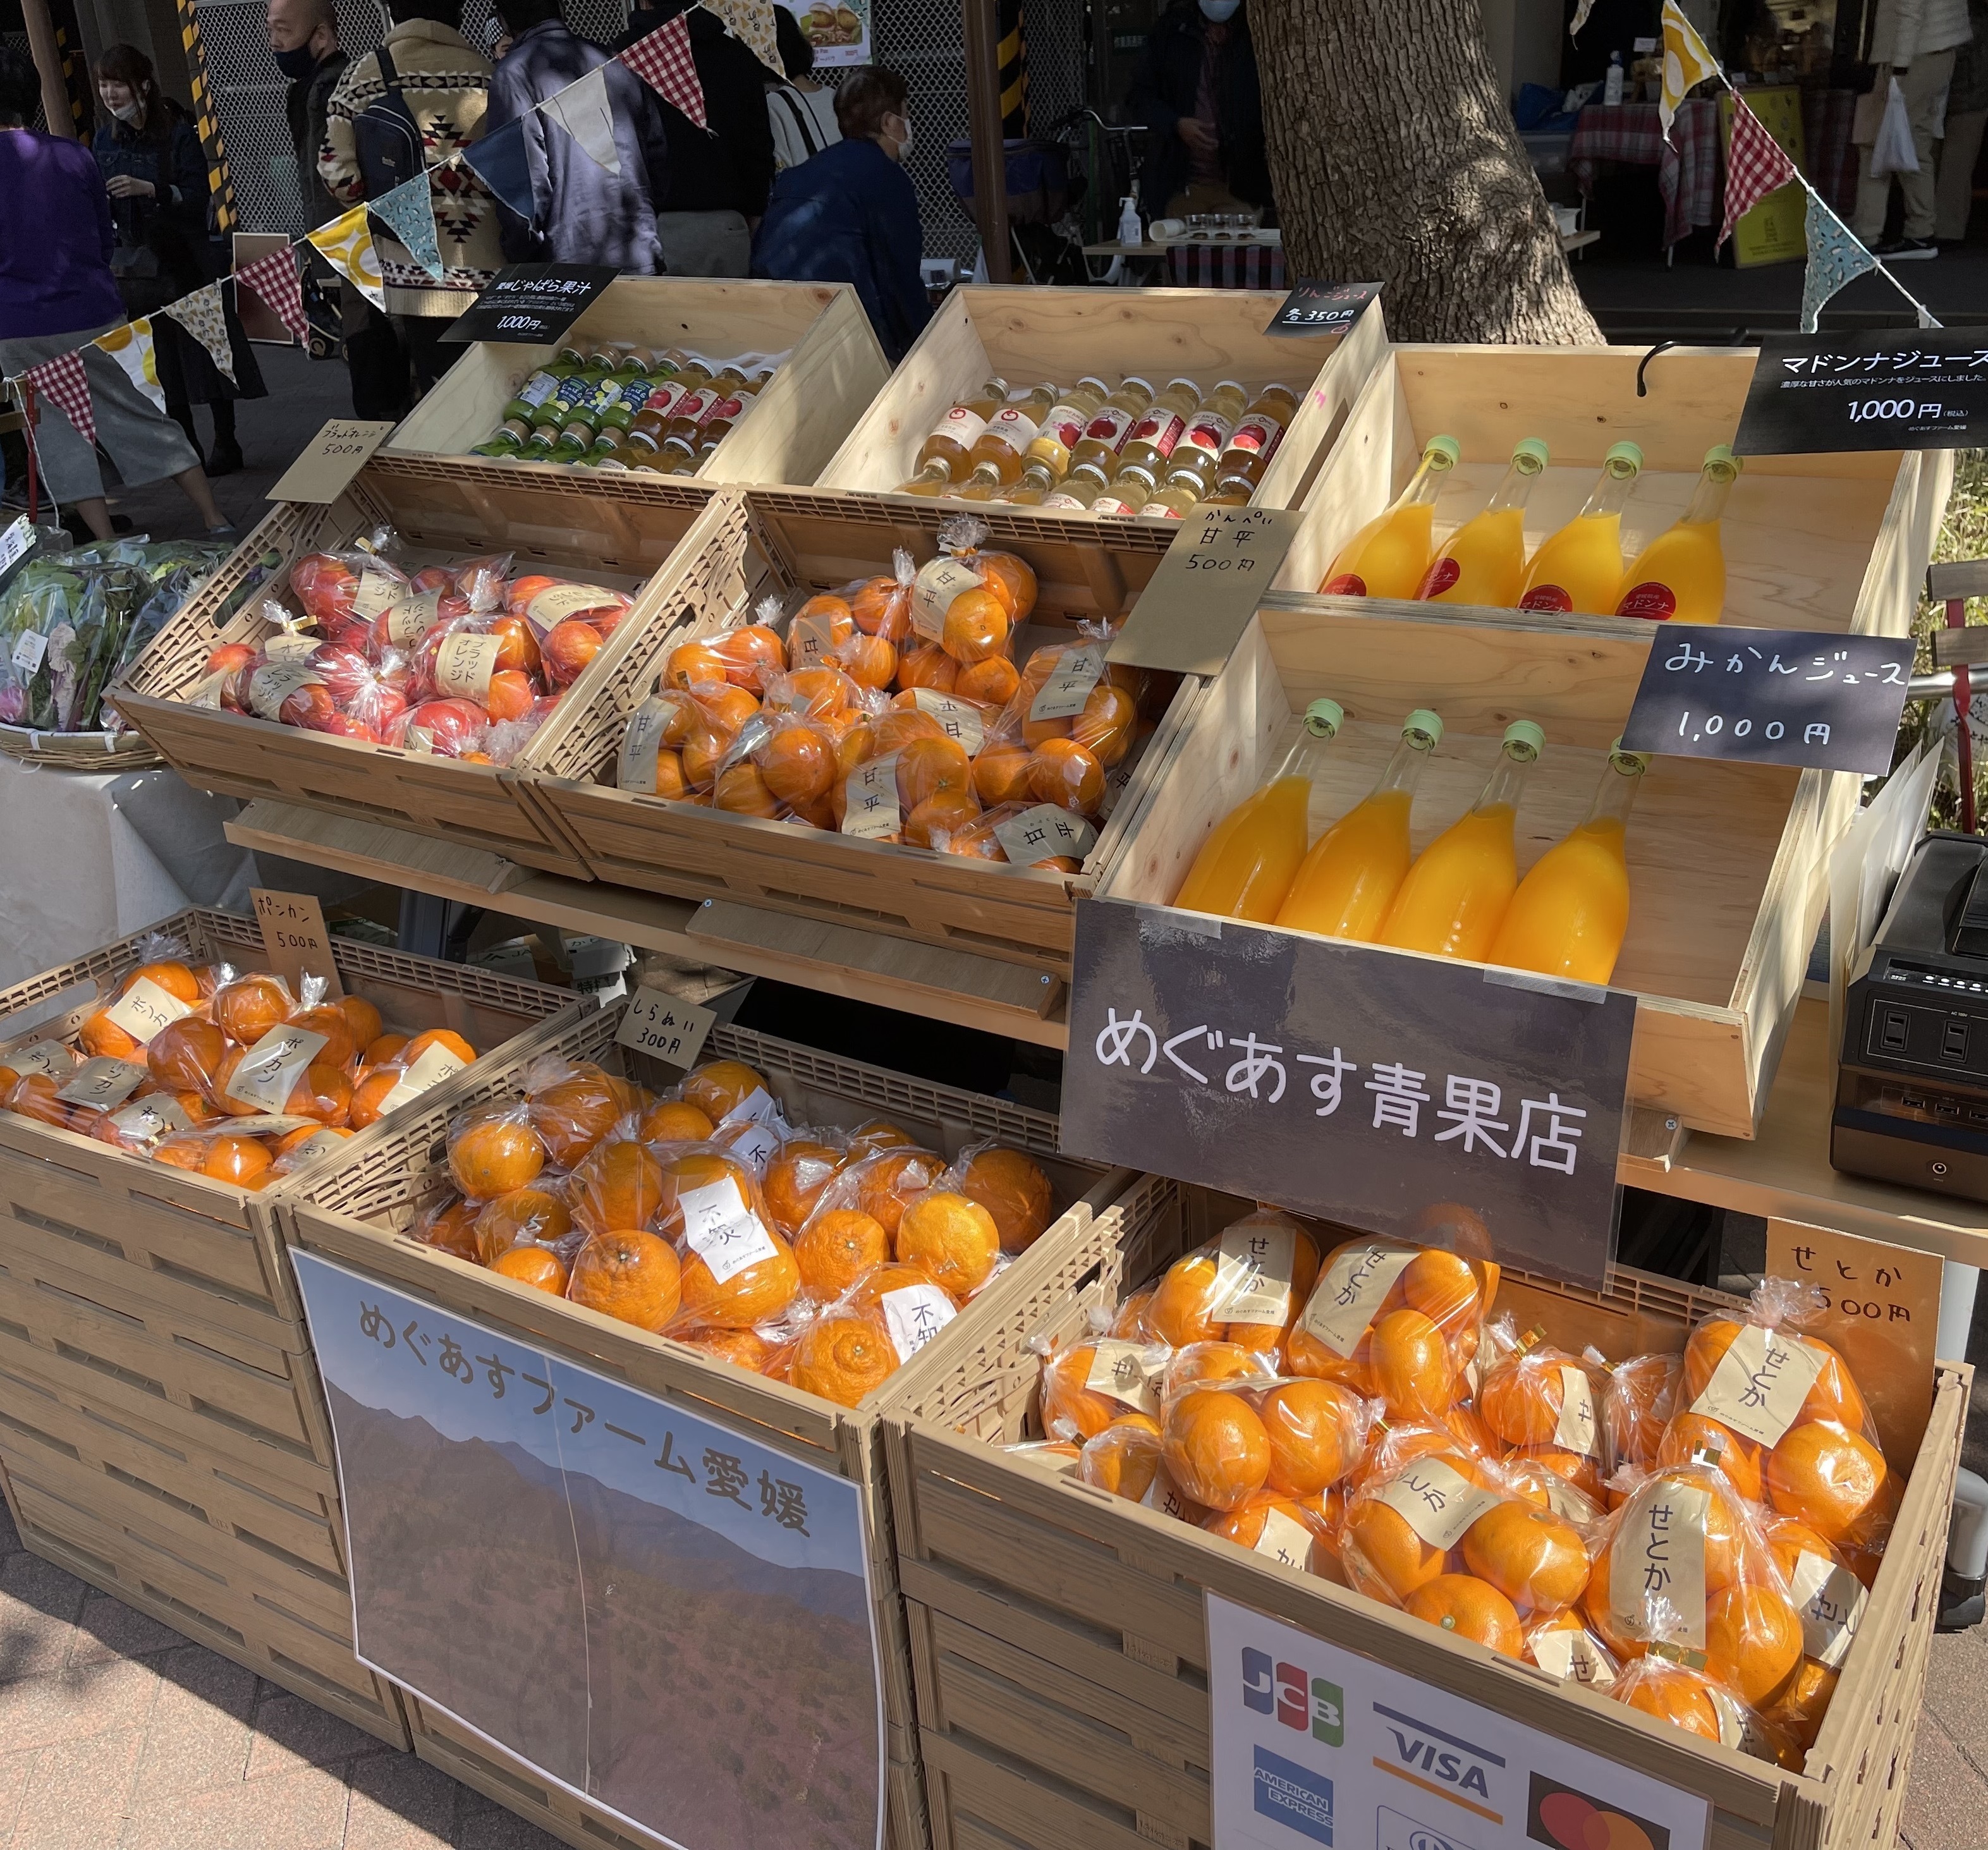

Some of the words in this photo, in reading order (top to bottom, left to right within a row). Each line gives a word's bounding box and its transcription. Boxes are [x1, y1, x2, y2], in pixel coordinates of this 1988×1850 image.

[497, 315, 542, 330] 1,000円
[1782, 350, 1988, 374] マドンナジュース
[1848, 399, 1942, 423] 1,000円
[322, 443, 363, 455] 500円
[1200, 527, 1255, 548] 甘平
[1185, 554, 1255, 572] 500円
[1623, 599, 1669, 609] マドンナ
[451, 639, 472, 681] オレンジ
[465, 640, 486, 683] ブラッド
[1664, 642, 1905, 685] みかんジュース
[628, 715, 651, 762] 甘平
[1678, 711, 1831, 745] 1,000円
[862, 766, 880, 812] 甘平
[258, 896, 310, 922] ポンカン
[276, 931, 318, 949] 500円
[131, 995, 169, 1027] ポンカ
[637, 1027, 681, 1055] 300円
[1095, 1006, 1587, 1176] めぐあす青果店
[1334, 1250, 1386, 1306] せとか
[1791, 1246, 1902, 1287] せとか
[1738, 1347, 1790, 1408] せとか
[360, 1301, 810, 1538] めぐあすファーム愛媛
[1644, 1504, 1674, 1591] せとか
[1243, 1666, 1343, 1733] JCB
[1386, 1727, 1489, 1799] VISA
[1255, 1767, 1328, 1813] AMERICAN
[1268, 1789, 1334, 1828] EXPRESS
